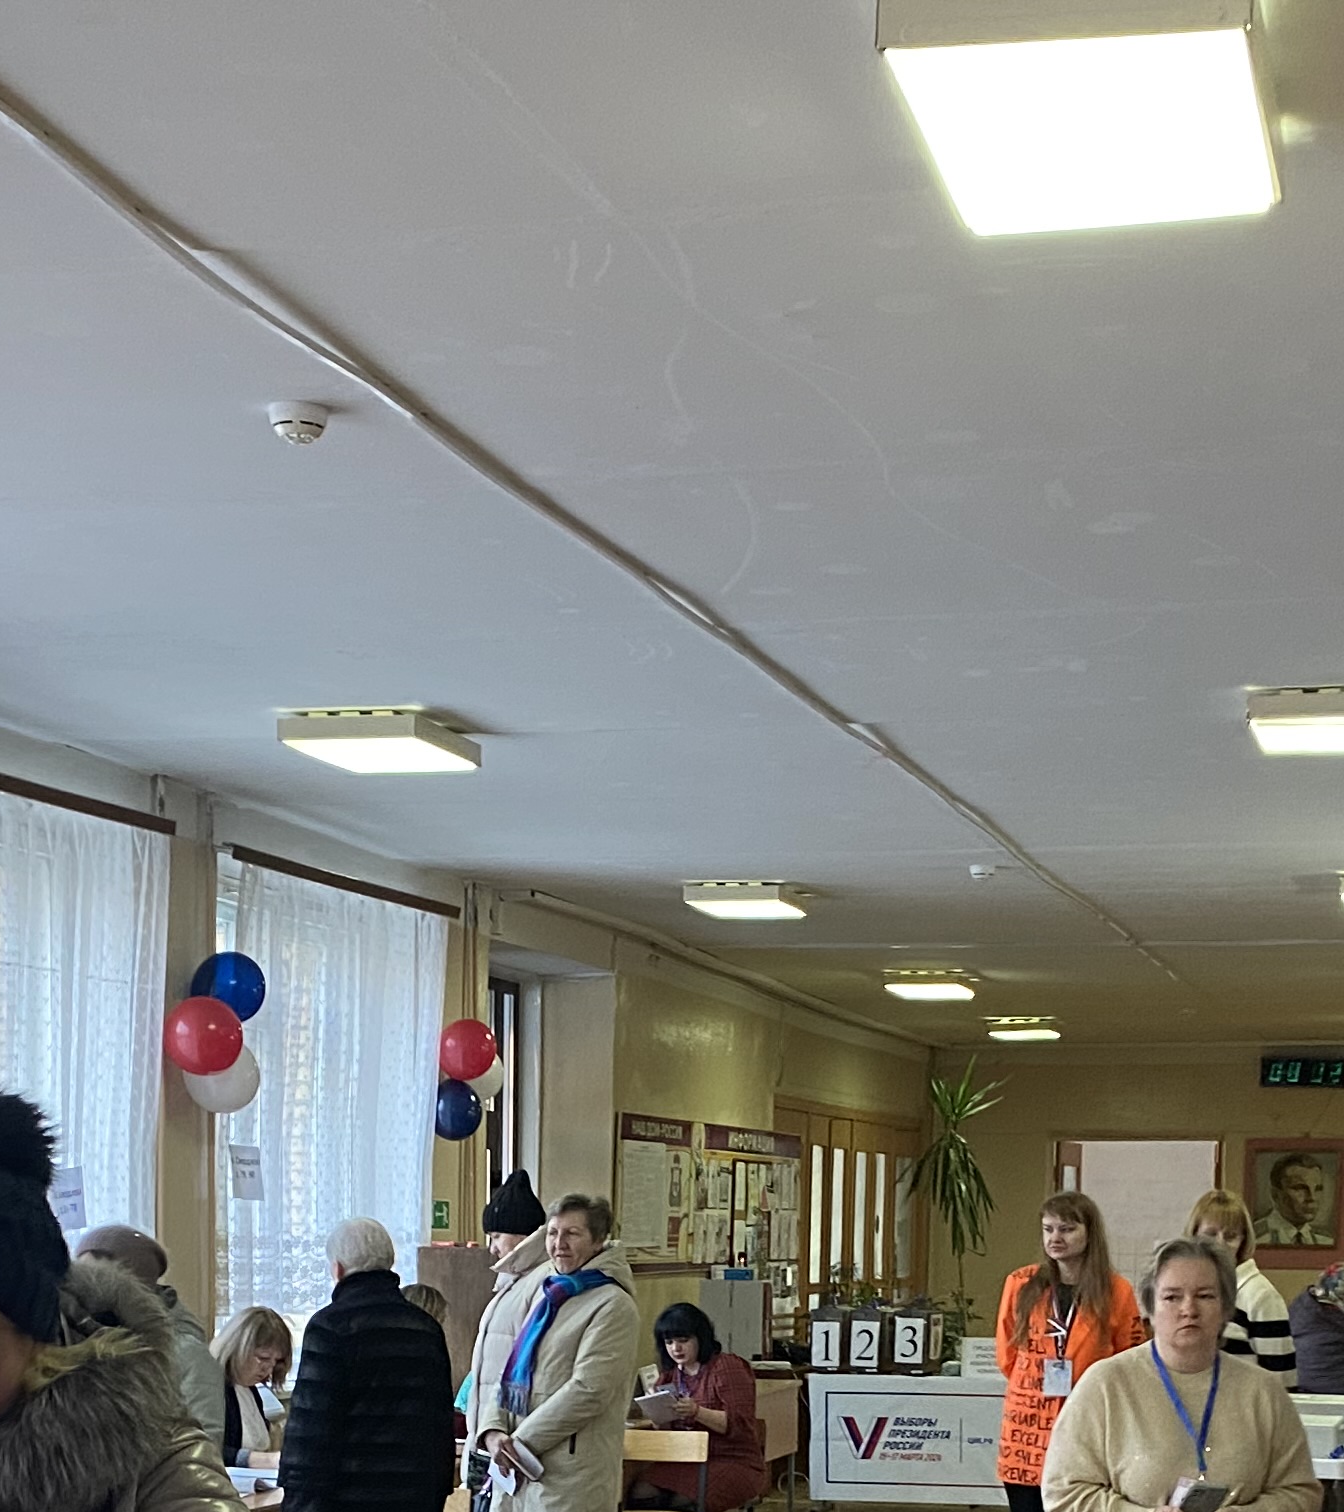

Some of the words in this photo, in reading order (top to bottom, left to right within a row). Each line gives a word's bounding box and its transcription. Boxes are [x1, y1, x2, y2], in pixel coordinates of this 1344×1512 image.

[821, 1330, 833, 1361] 1
[855, 1329, 875, 1361] 2
[900, 1326, 918, 1358] 3
[892, 1417, 938, 1427] ВЫБОРЫ
[887, 1429, 951, 1440] ПРЕЗИДЕНТА
[882, 1441, 924, 1450] РОССИИ
